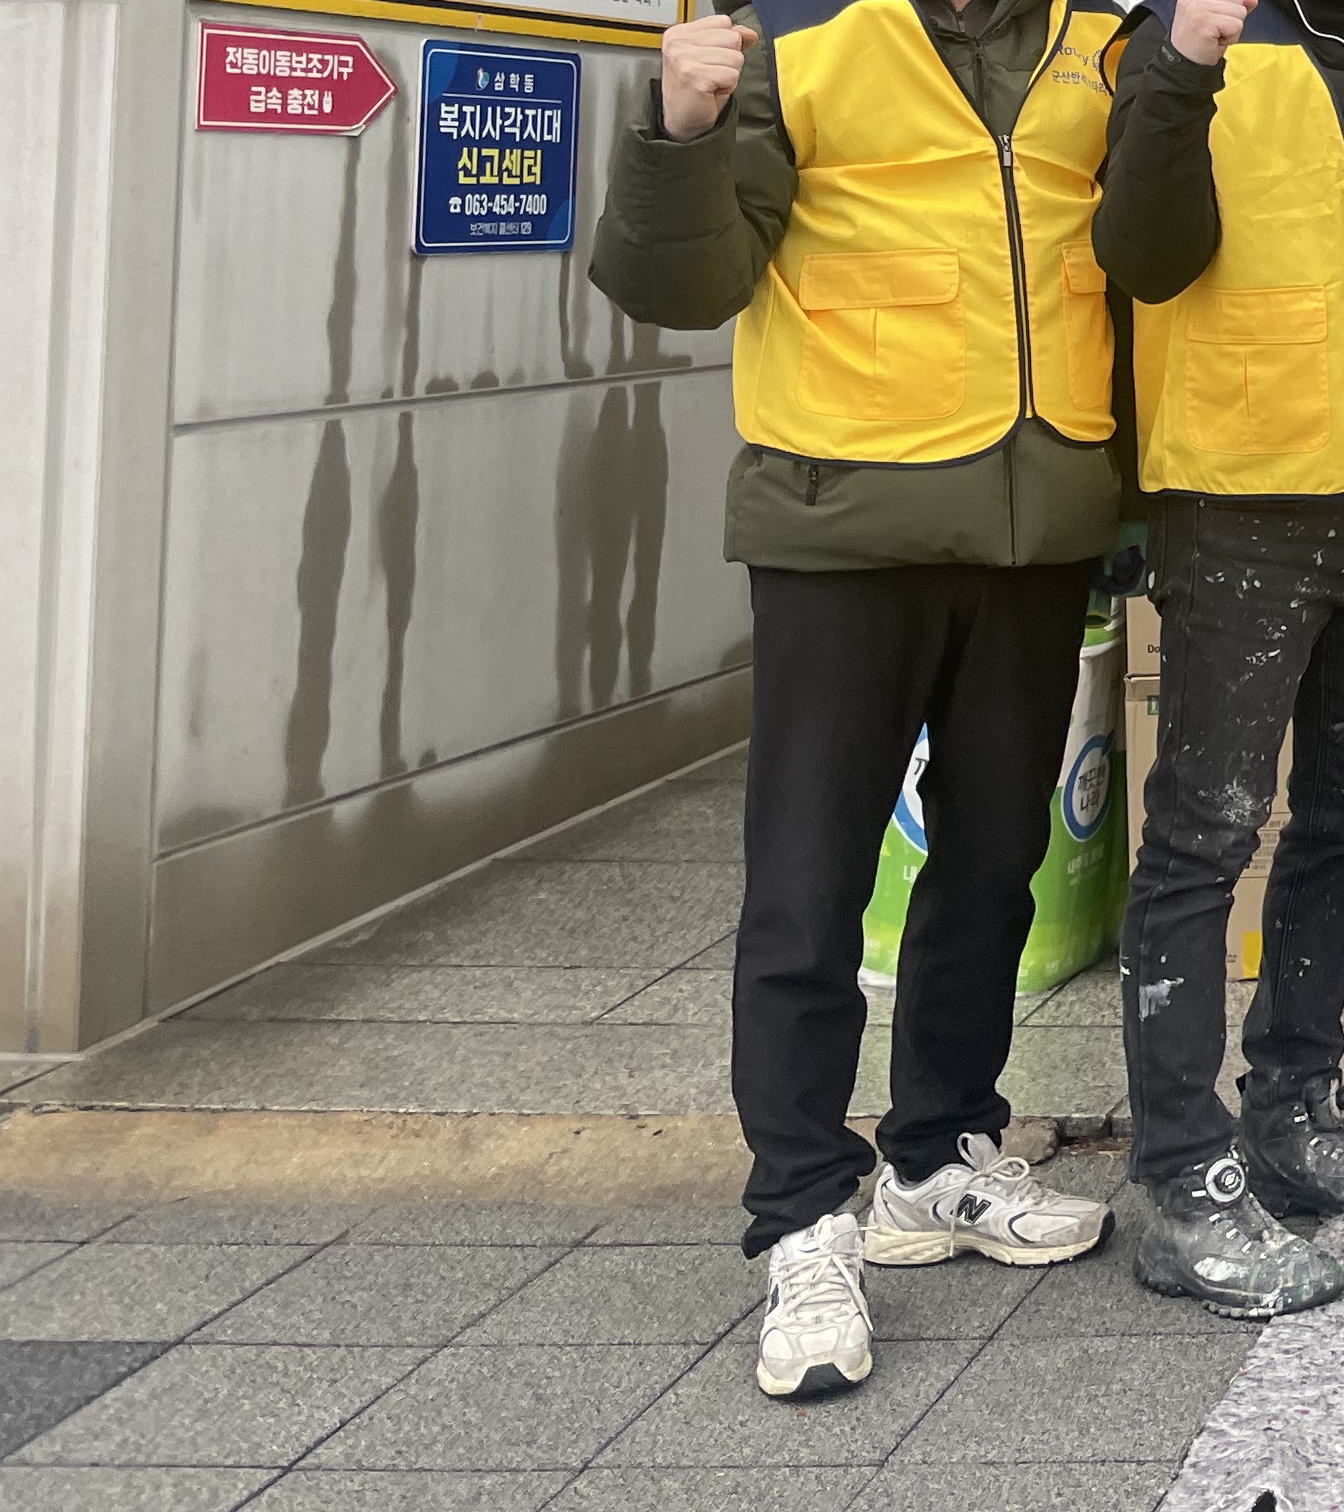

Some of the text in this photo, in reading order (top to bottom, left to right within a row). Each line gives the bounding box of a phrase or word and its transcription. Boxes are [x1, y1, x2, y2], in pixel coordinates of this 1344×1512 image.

[225, 47, 353, 81] 전동이동보조기구
[249, 87, 319, 115] 급속 충전
[439, 104, 562, 143] 복지사각지대
[458, 147, 542, 185] 신고센터
[465, 193, 547, 215] 063-454-7400
